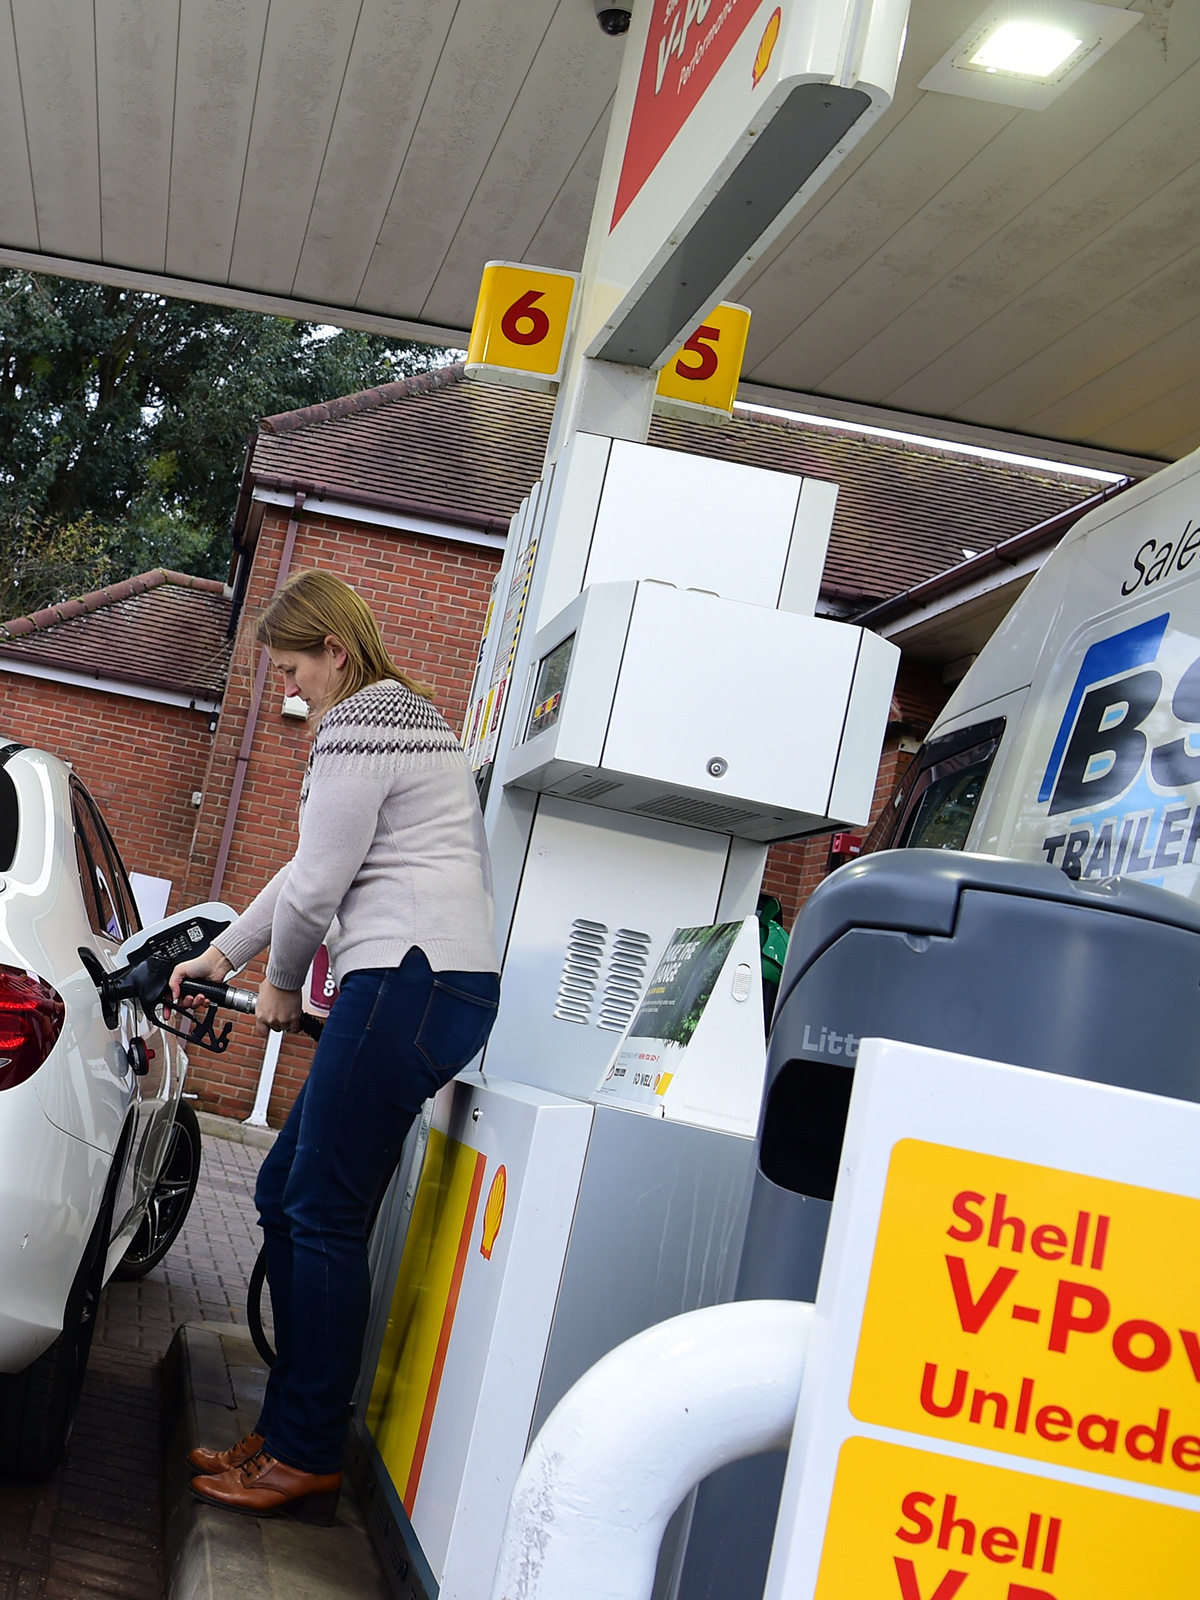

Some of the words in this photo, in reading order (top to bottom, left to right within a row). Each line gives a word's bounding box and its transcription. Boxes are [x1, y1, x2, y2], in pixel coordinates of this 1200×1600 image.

[500, 289, 550, 346] 6
[675, 324, 721, 381] 5
[946, 1190, 1111, 1271] Shell
[895, 1491, 1062, 1575] Shell
